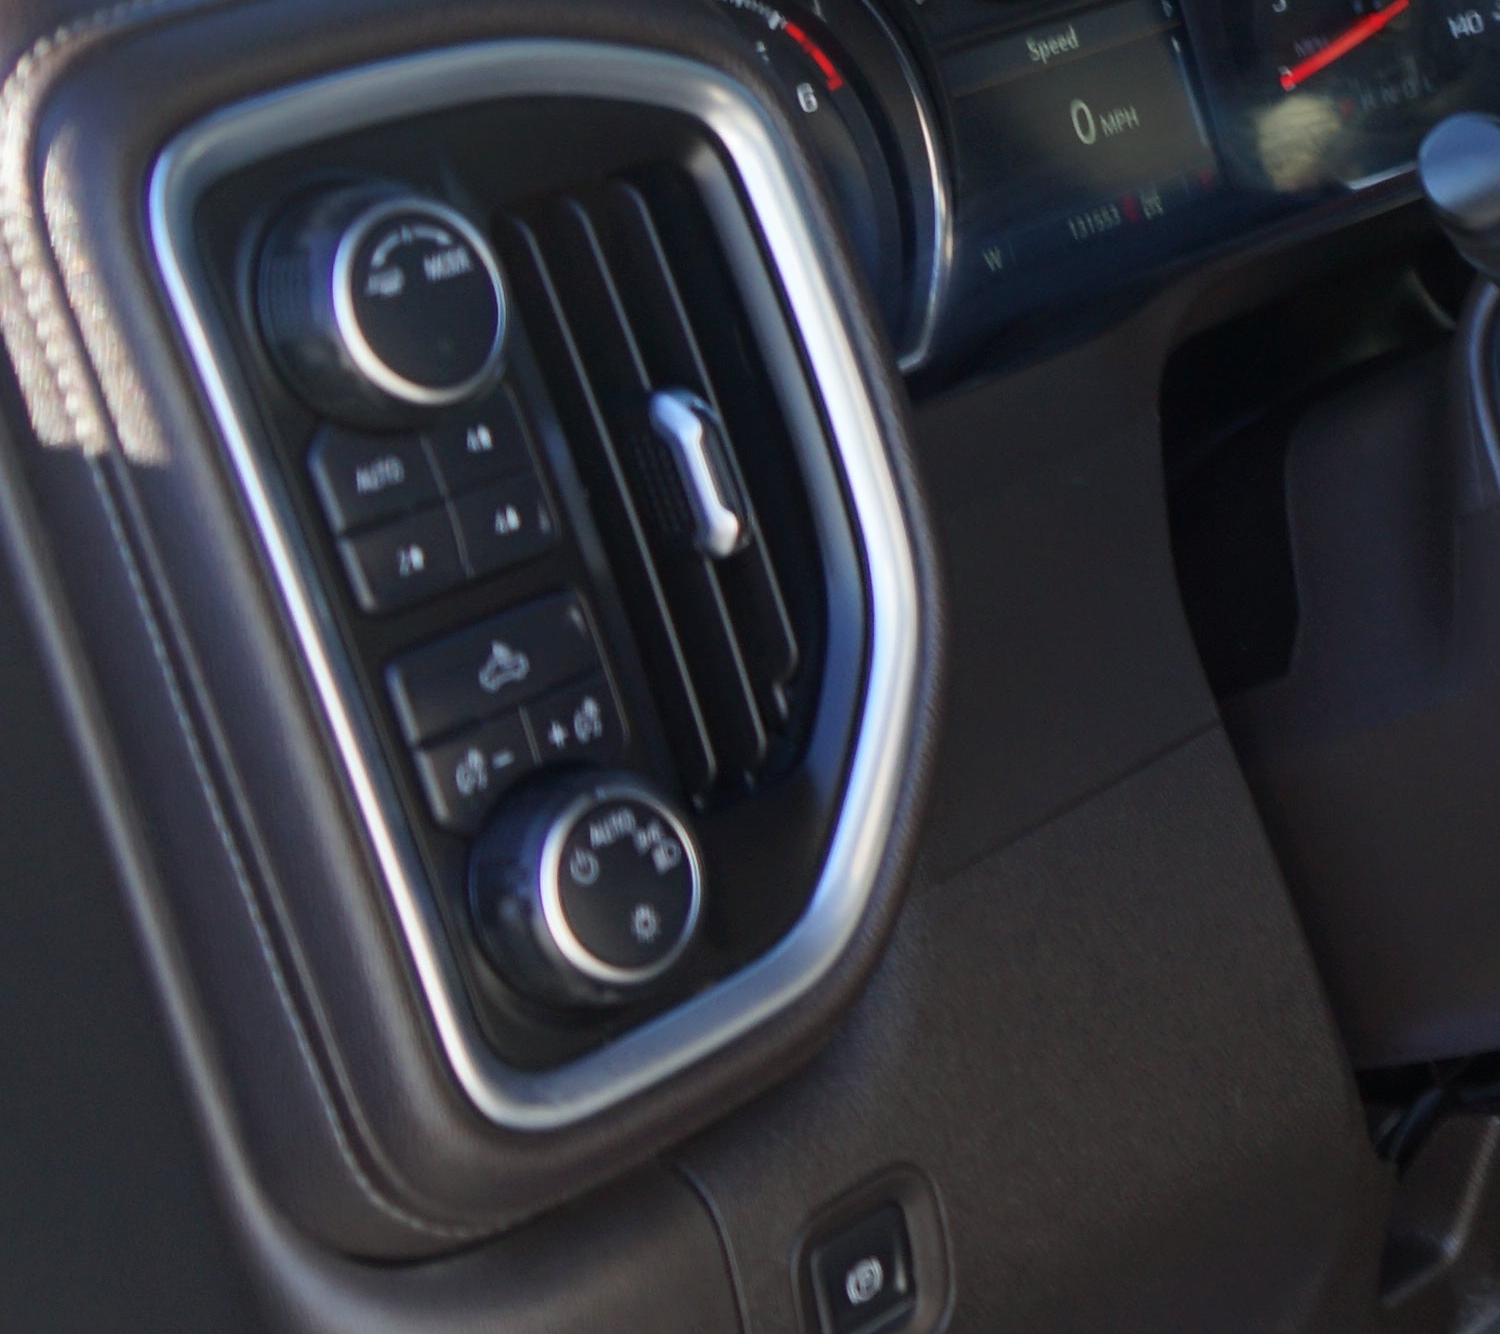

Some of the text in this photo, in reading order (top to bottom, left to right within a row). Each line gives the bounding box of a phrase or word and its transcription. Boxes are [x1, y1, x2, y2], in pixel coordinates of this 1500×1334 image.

[1026, 23, 1079, 64] Speed
[796, 82, 818, 113] 6
[1099, 104, 1140, 138] MPH
